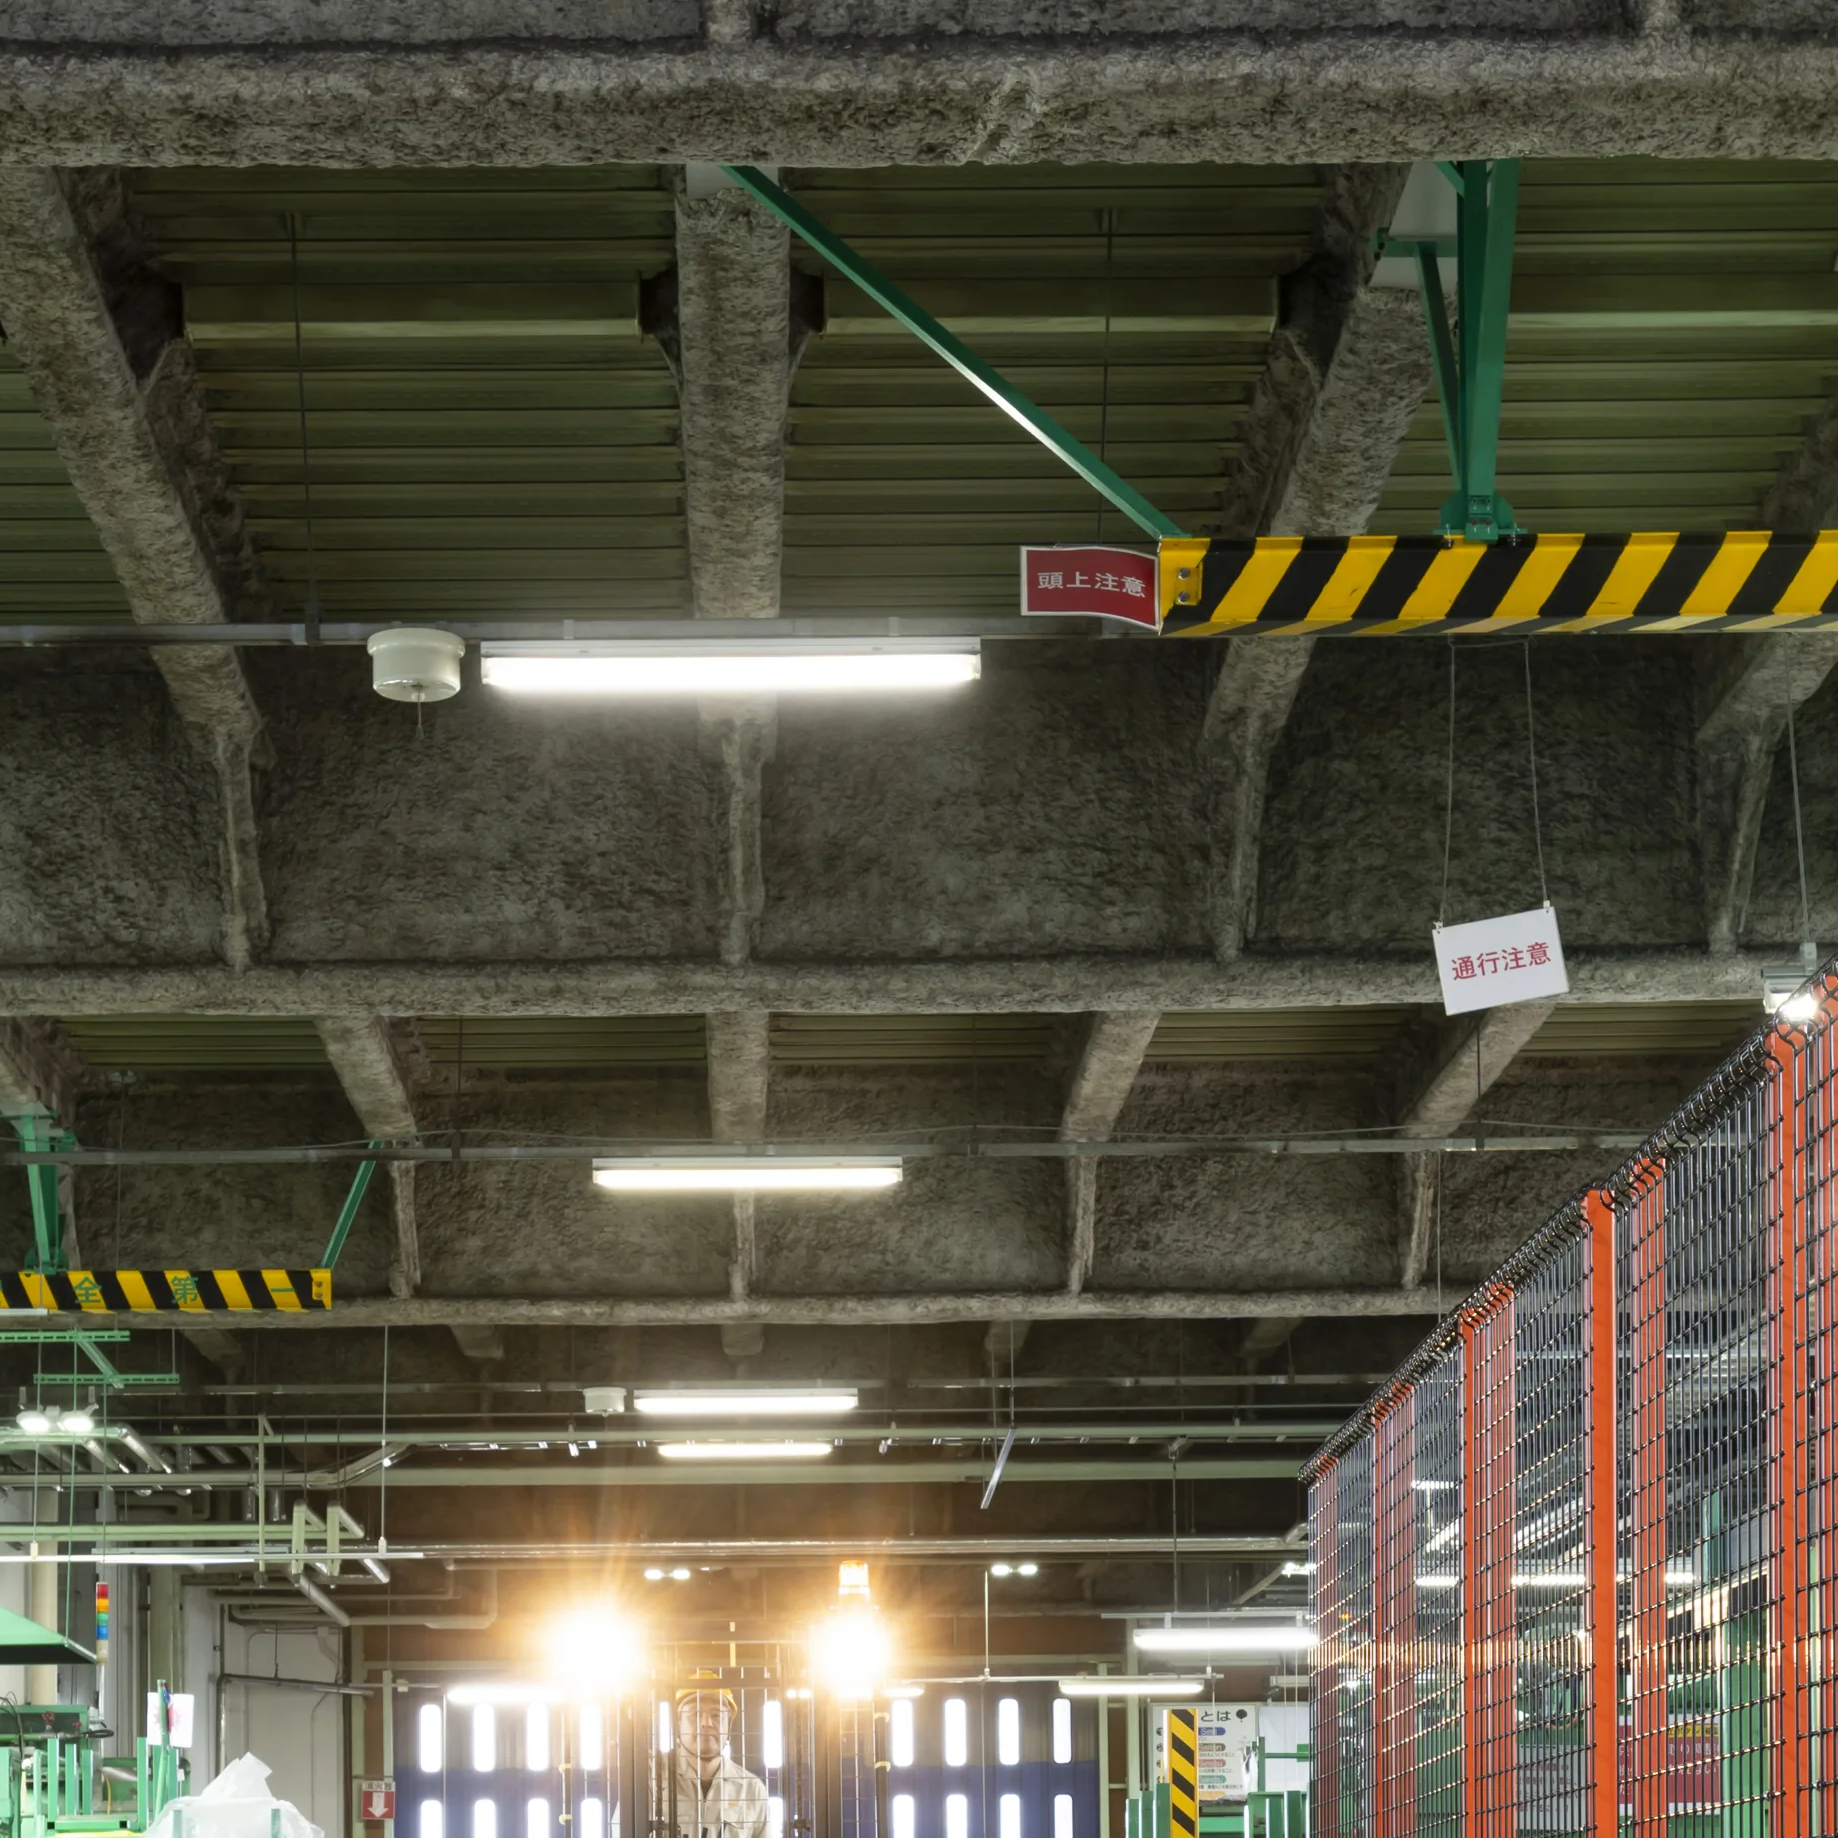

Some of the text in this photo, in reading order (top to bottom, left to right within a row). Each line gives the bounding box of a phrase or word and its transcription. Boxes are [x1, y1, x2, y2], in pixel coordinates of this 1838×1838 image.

[1037, 571, 1146, 598] 頭上注意
[1451, 941, 1552, 981] 通行注意
